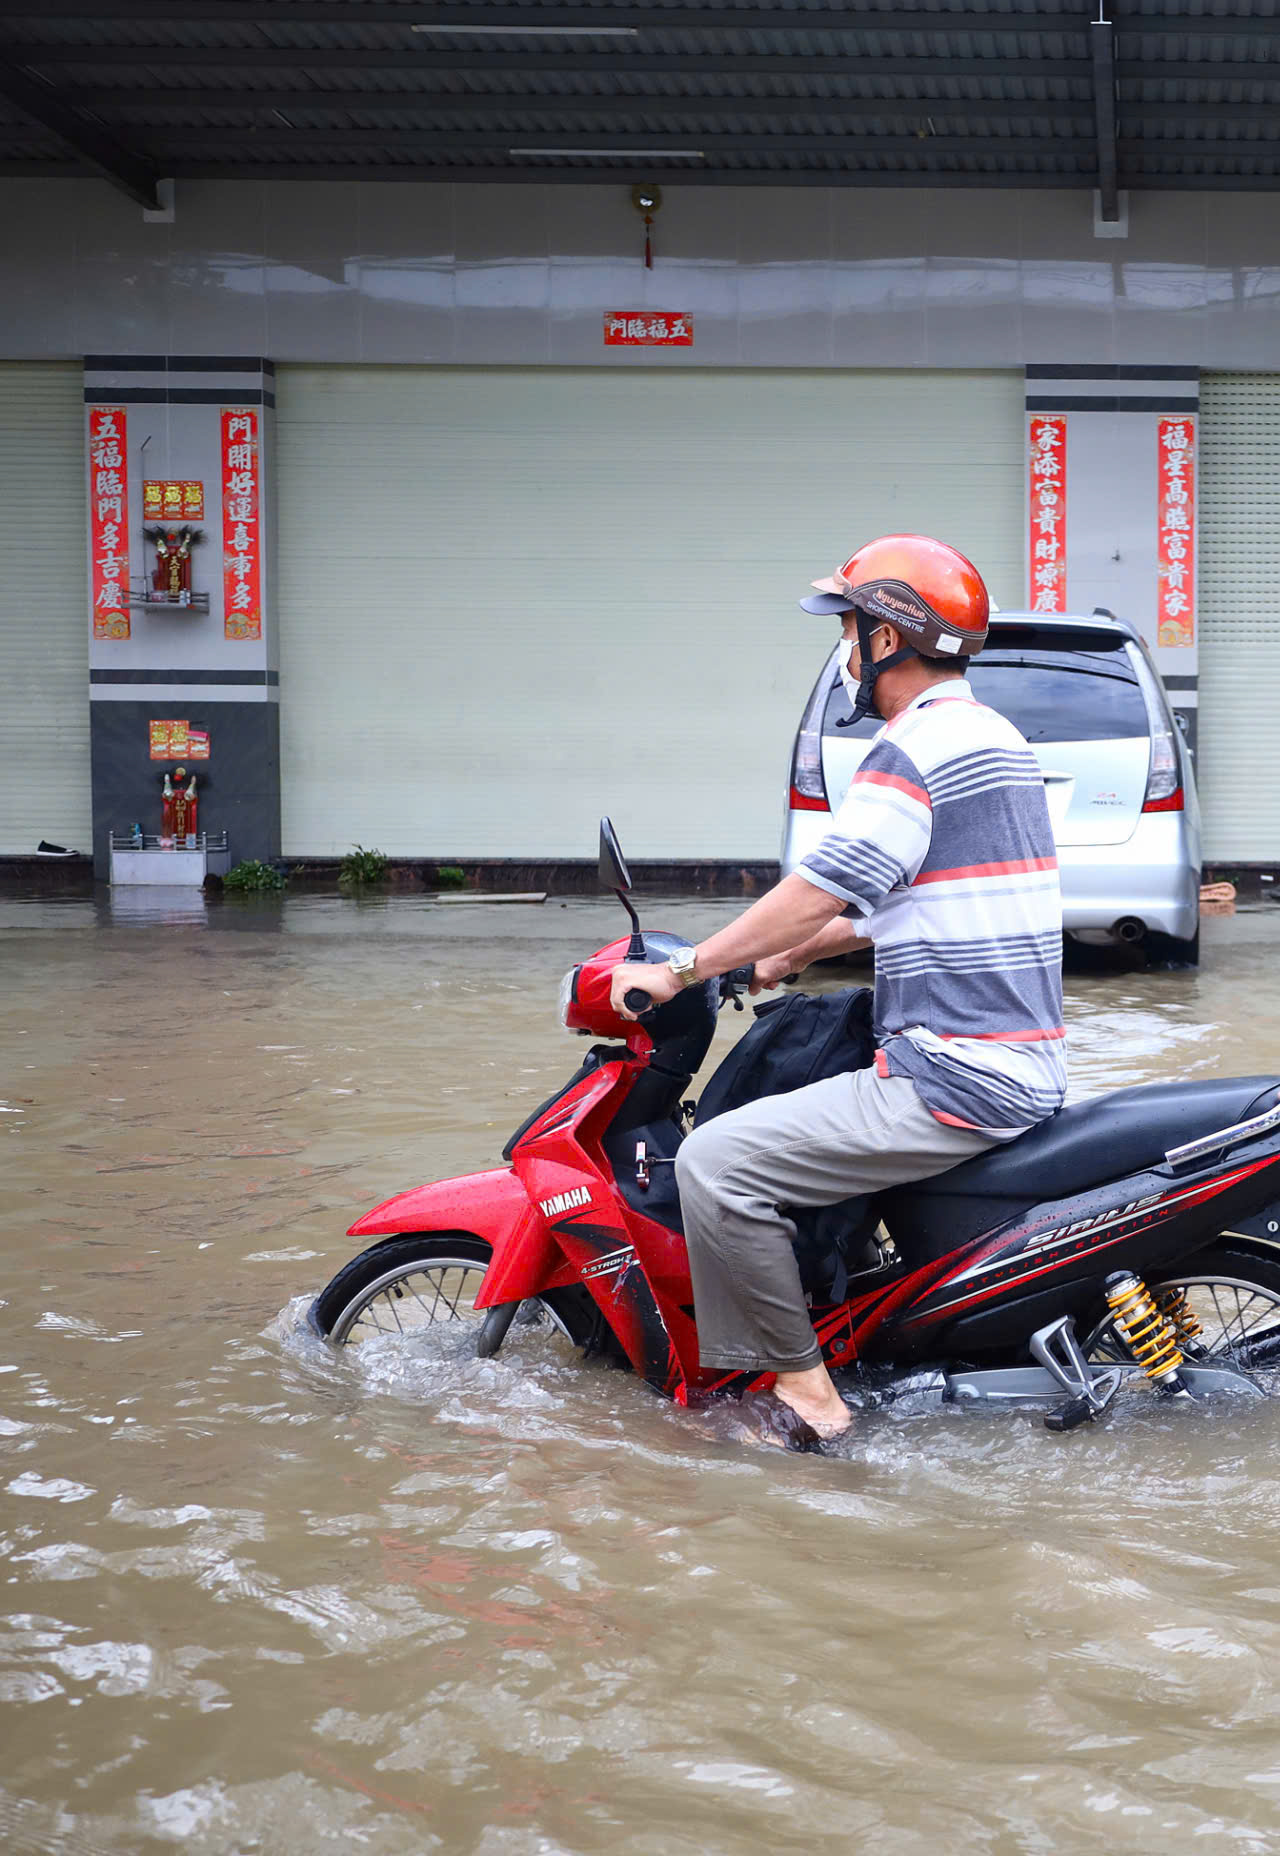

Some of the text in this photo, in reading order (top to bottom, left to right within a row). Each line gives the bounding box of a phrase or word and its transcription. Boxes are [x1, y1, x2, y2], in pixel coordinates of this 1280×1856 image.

[226, 416, 256, 609] 門開好運喜事多
[866, 600, 926, 634] SHOPPING CENTRE
[539, 1185, 593, 1218] YAMAHA
[1025, 1190, 1167, 1250] SIRIUS
[581, 1253, 634, 1275] 4-STROKE
